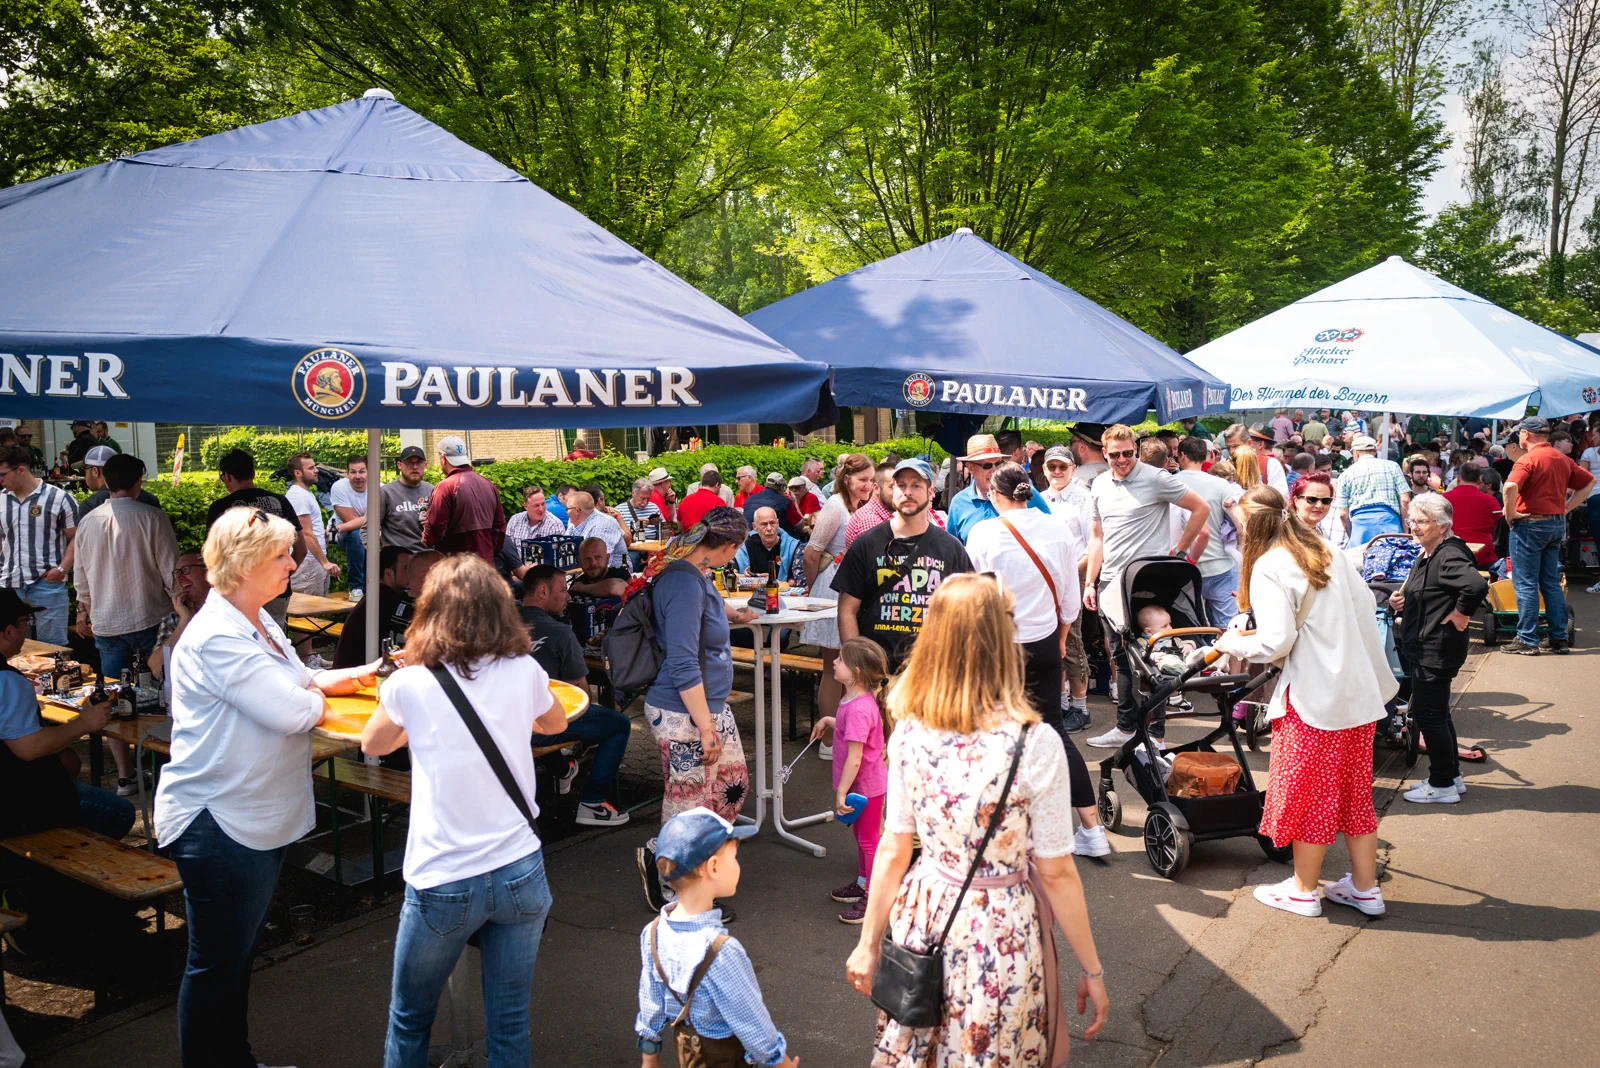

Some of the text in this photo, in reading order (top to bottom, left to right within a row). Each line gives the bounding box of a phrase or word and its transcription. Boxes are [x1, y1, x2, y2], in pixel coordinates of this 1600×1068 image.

[298, 351, 360, 376] PAULANER
[0, 352, 130, 399] NER
[380, 361, 702, 408] PAULANER
[304, 397, 356, 416] MÜNCHEN
[940, 380, 1089, 412] PAULANER
[1231, 386, 1390, 406] Der Himmel der Bayern
[395, 501, 420, 512] elle
[926, 556, 945, 571] DICH
